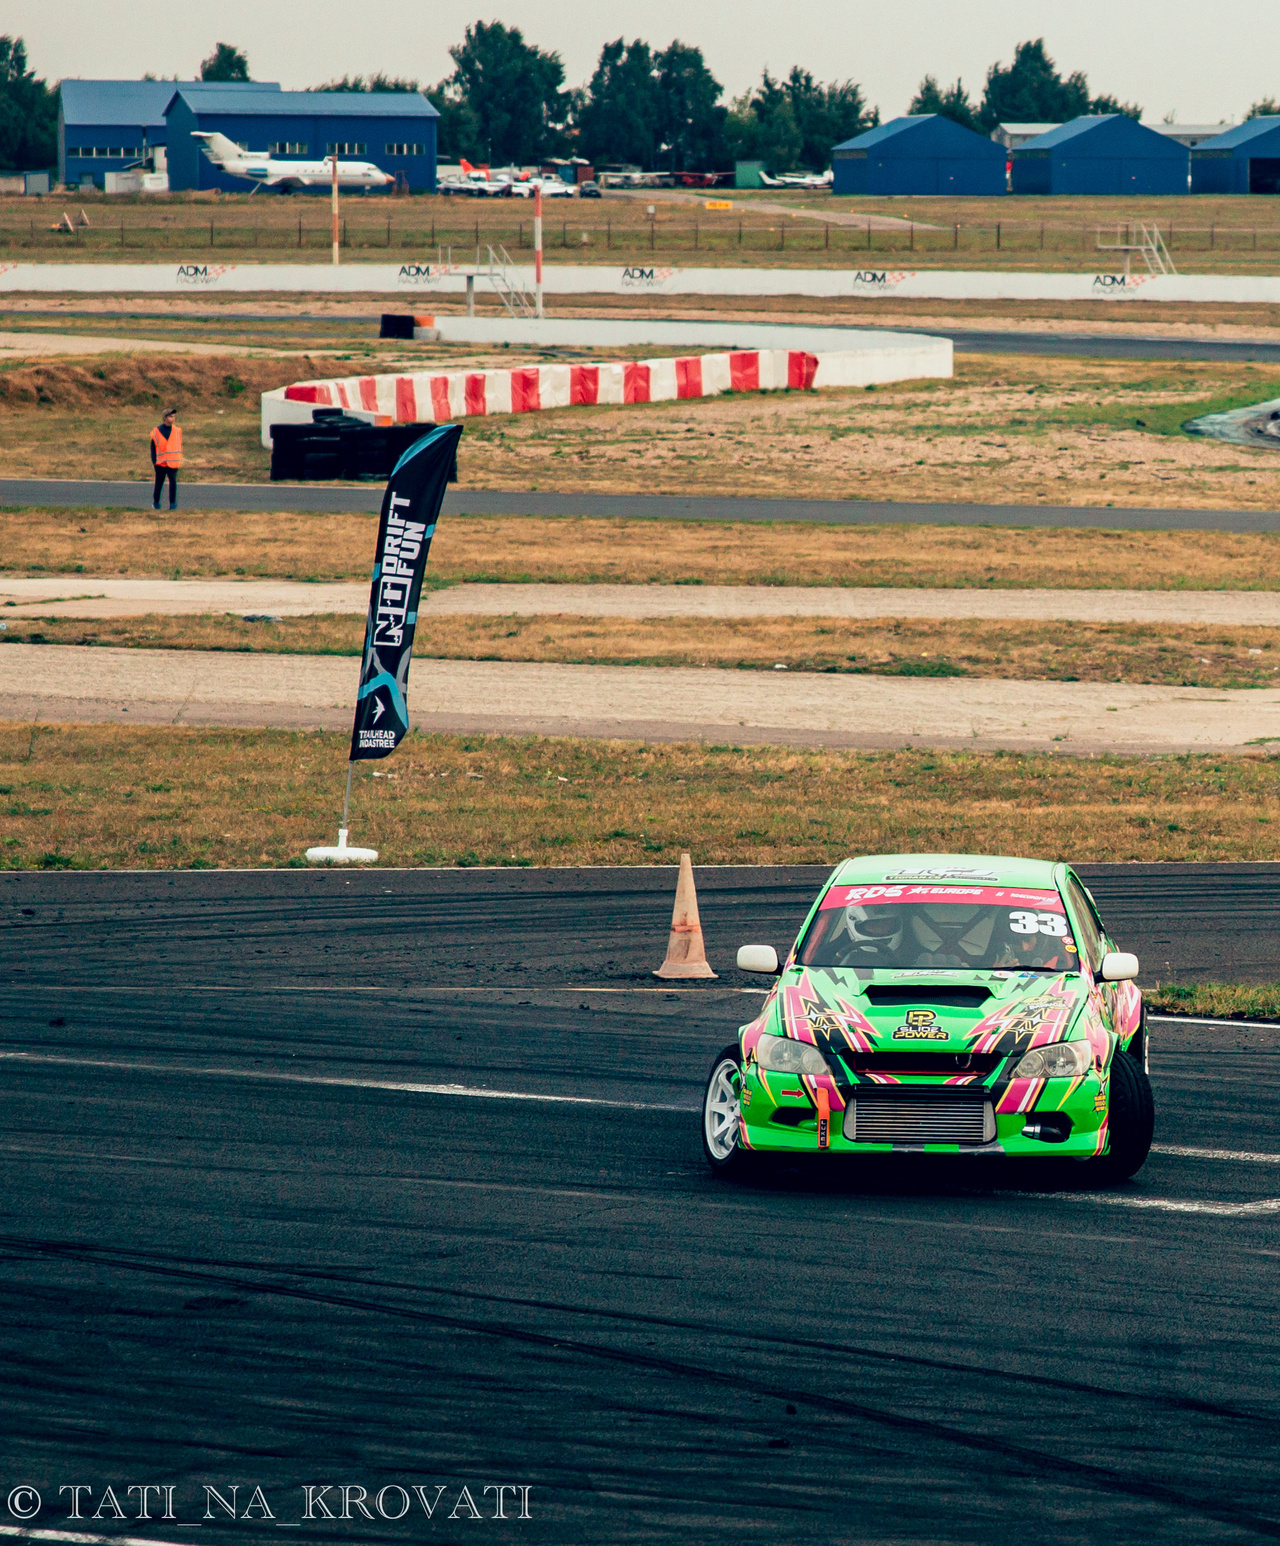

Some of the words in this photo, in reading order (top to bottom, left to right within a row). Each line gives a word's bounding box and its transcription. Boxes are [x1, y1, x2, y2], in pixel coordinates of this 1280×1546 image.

[177, 265, 208, 276] ADM
[399, 265, 430, 276] ADM
[622, 268, 654, 279] ADM
[854, 271, 886, 283] ADM
[1093, 275, 1126, 286] ADM
[381, 491, 411, 575] DRIFT
[396, 521, 426, 577] FUN
[359, 730, 396, 739] TRAILHEAD
[845, 885, 908, 900] RDS
[1009, 911, 1068, 937] 33
[895, 1031, 947, 1039] POWER
